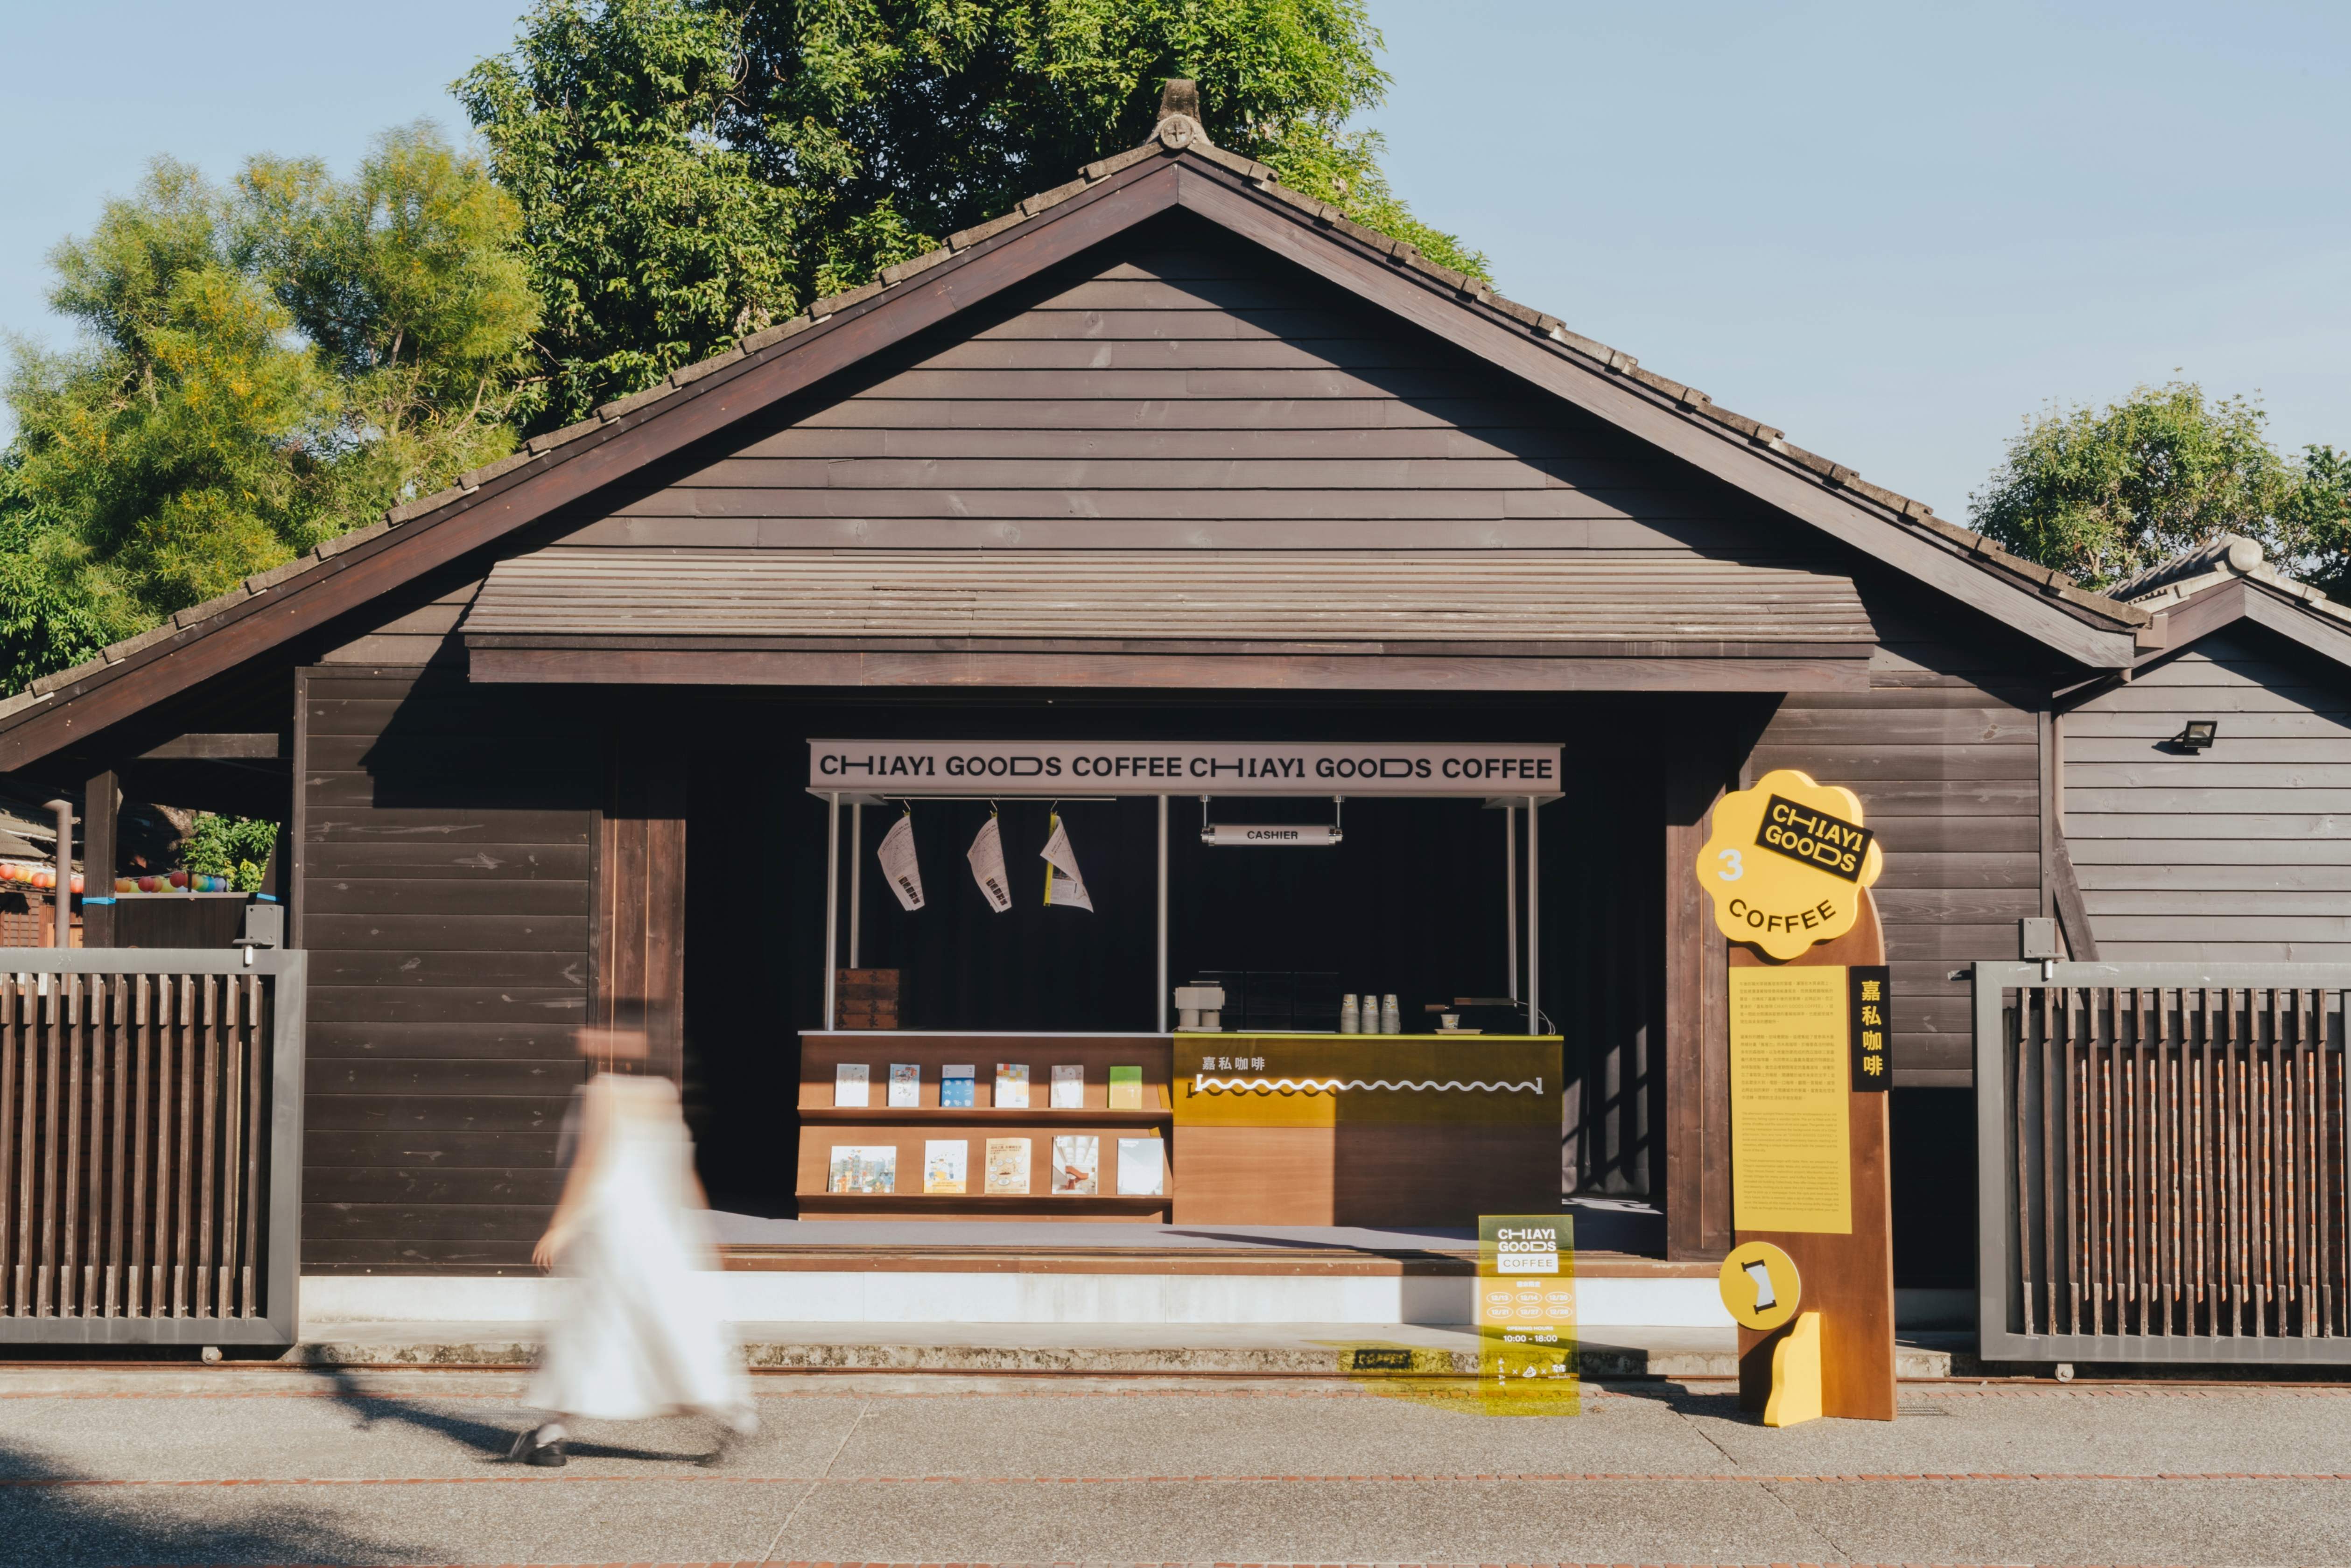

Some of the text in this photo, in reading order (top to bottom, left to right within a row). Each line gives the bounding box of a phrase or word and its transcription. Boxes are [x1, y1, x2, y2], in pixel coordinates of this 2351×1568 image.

[820, 755, 1552, 779] CHIAYI GOODS COFFEE CHIAYI GOODS COFFEE
[1247, 830, 1298, 840] CASHIER
[1773, 804, 1863, 852] CHIAYI
[1765, 825, 1856, 872] GOODS
[1718, 849, 1743, 881] 3
[1729, 899, 1836, 933] COFFEE
[1861, 980, 1883, 1076] 嘉私咖啡
[1202, 1056, 1265, 1071] 嘉私咖啡
[1498, 1229, 1556, 1239] CHIAYI
[1498, 1241, 1557, 1252] GOODS
[1503, 1259, 1553, 1267] COFFEE
